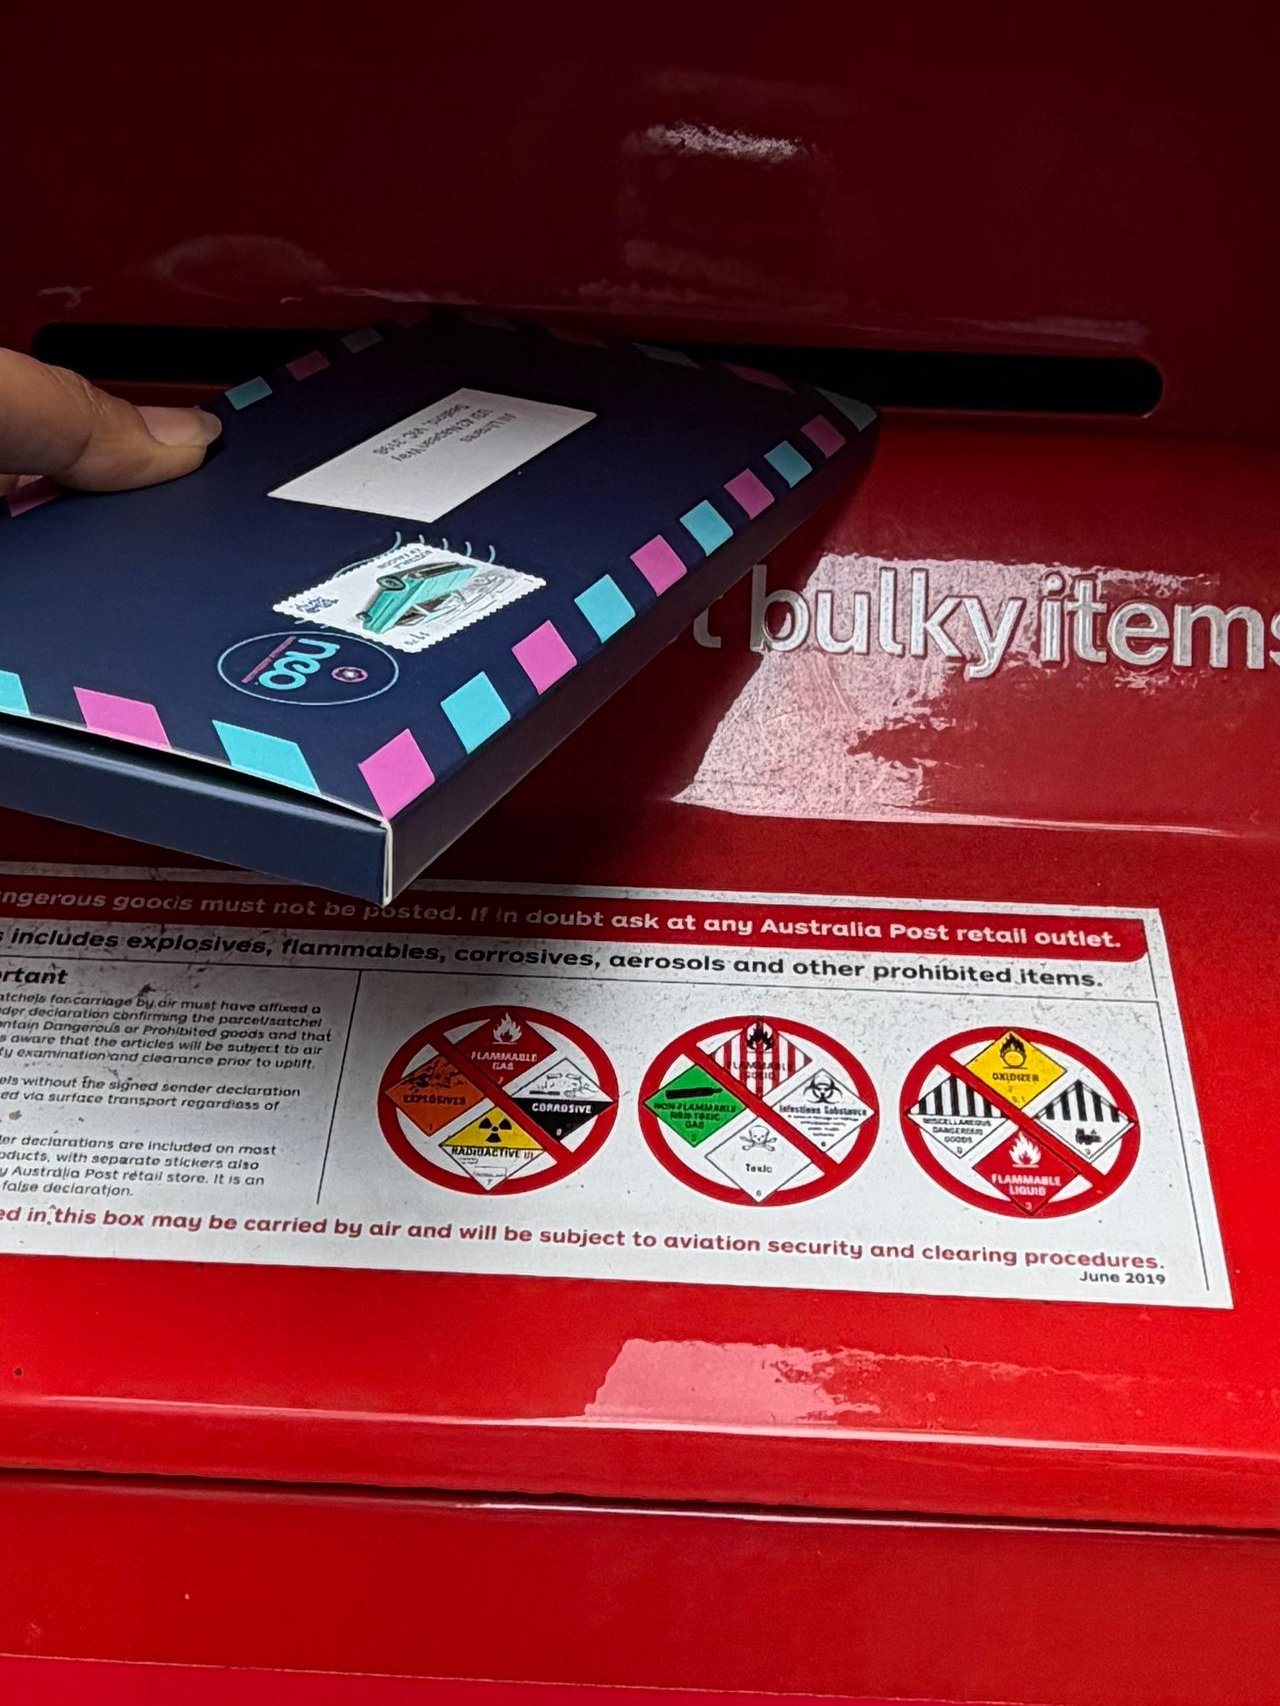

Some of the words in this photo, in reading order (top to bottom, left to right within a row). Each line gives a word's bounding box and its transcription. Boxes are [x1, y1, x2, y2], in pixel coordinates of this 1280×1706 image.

[752, 565, 1023, 680] bulky
[112, 895, 192, 910] goods
[199, 898, 266, 913] must
[272, 900, 317, 915] not
[323, 901, 355, 916] be
[362, 902, 462, 920] posted.
[470, 906, 488, 922] If
[496, 907, 517, 923] in
[525, 909, 603, 926] doubt
[611, 913, 659, 929] ask
[667, 915, 696, 930] at
[703, 919, 752, 935] any
[760, 918, 882, 938] Australia
[889, 923, 949, 940] Post
[956, 927, 1027, 944] retail
[1034, 930, 1121, 947] outlet.
[11, 928, 118, 951] includes
[126, 932, 272, 956] explosives,
[282, 938, 445, 963] flammables,
[454, 949, 600, 969] corrosives,
[609, 955, 725, 971] aerosols
[733, 958, 783, 973] and
[792, 959, 865, 976] other
[873, 964, 1011, 983] prohibited
[1020, 968, 1102, 986] items.
[992, 1072, 1039, 1082] OXIDIZER
[21, 1076, 77, 1088] without
[81, 1077, 105, 1088] the
[108, 1079, 158, 1092] signed
[161, 1083, 213, 1093] sender
[215, 1084, 300, 1096] declaration
[532, 1103, 592, 1113] CORROSIVE
[21, 1135, 114, 1149] declarations
[118, 1141, 144, 1150] are
[148, 1141, 212, 1152] included
[215, 1145, 234, 1153] on
[238, 1145, 276, 1155] most
[452, 1147, 520, 1159] RADIOACTIVE
[746, 1163, 772, 1173] Toxic
[992, 1174, 1060, 1185] FLAMMABLE
[1009, 1186, 1046, 1196] LIQUID
[27, 1206, 48, 1223] in
[54, 1207, 97, 1225] this
[102, 1210, 144, 1226] box
[152, 1215, 202, 1231] may
[208, 1214, 237, 1229] be
[244, 1217, 327, 1233] carried
[334, 1219, 362, 1238] by
[369, 1221, 401, 1236] air
[407, 1224, 452, 1238] and
[459, 1225, 496, 1240] will
[504, 1226, 532, 1241] be
[539, 1228, 625, 1247] subject
[633, 1231, 656, 1247] to
[664, 1233, 760, 1251] aviation
[768, 1240, 862, 1259] security
[870, 1244, 914, 1258] and
[922, 1245, 1017, 1266] clearing
[1026, 1252, 1164, 1270] procedures.
[1079, 1271, 1119, 1282] June
[1125, 1272, 1165, 1284] 2019
